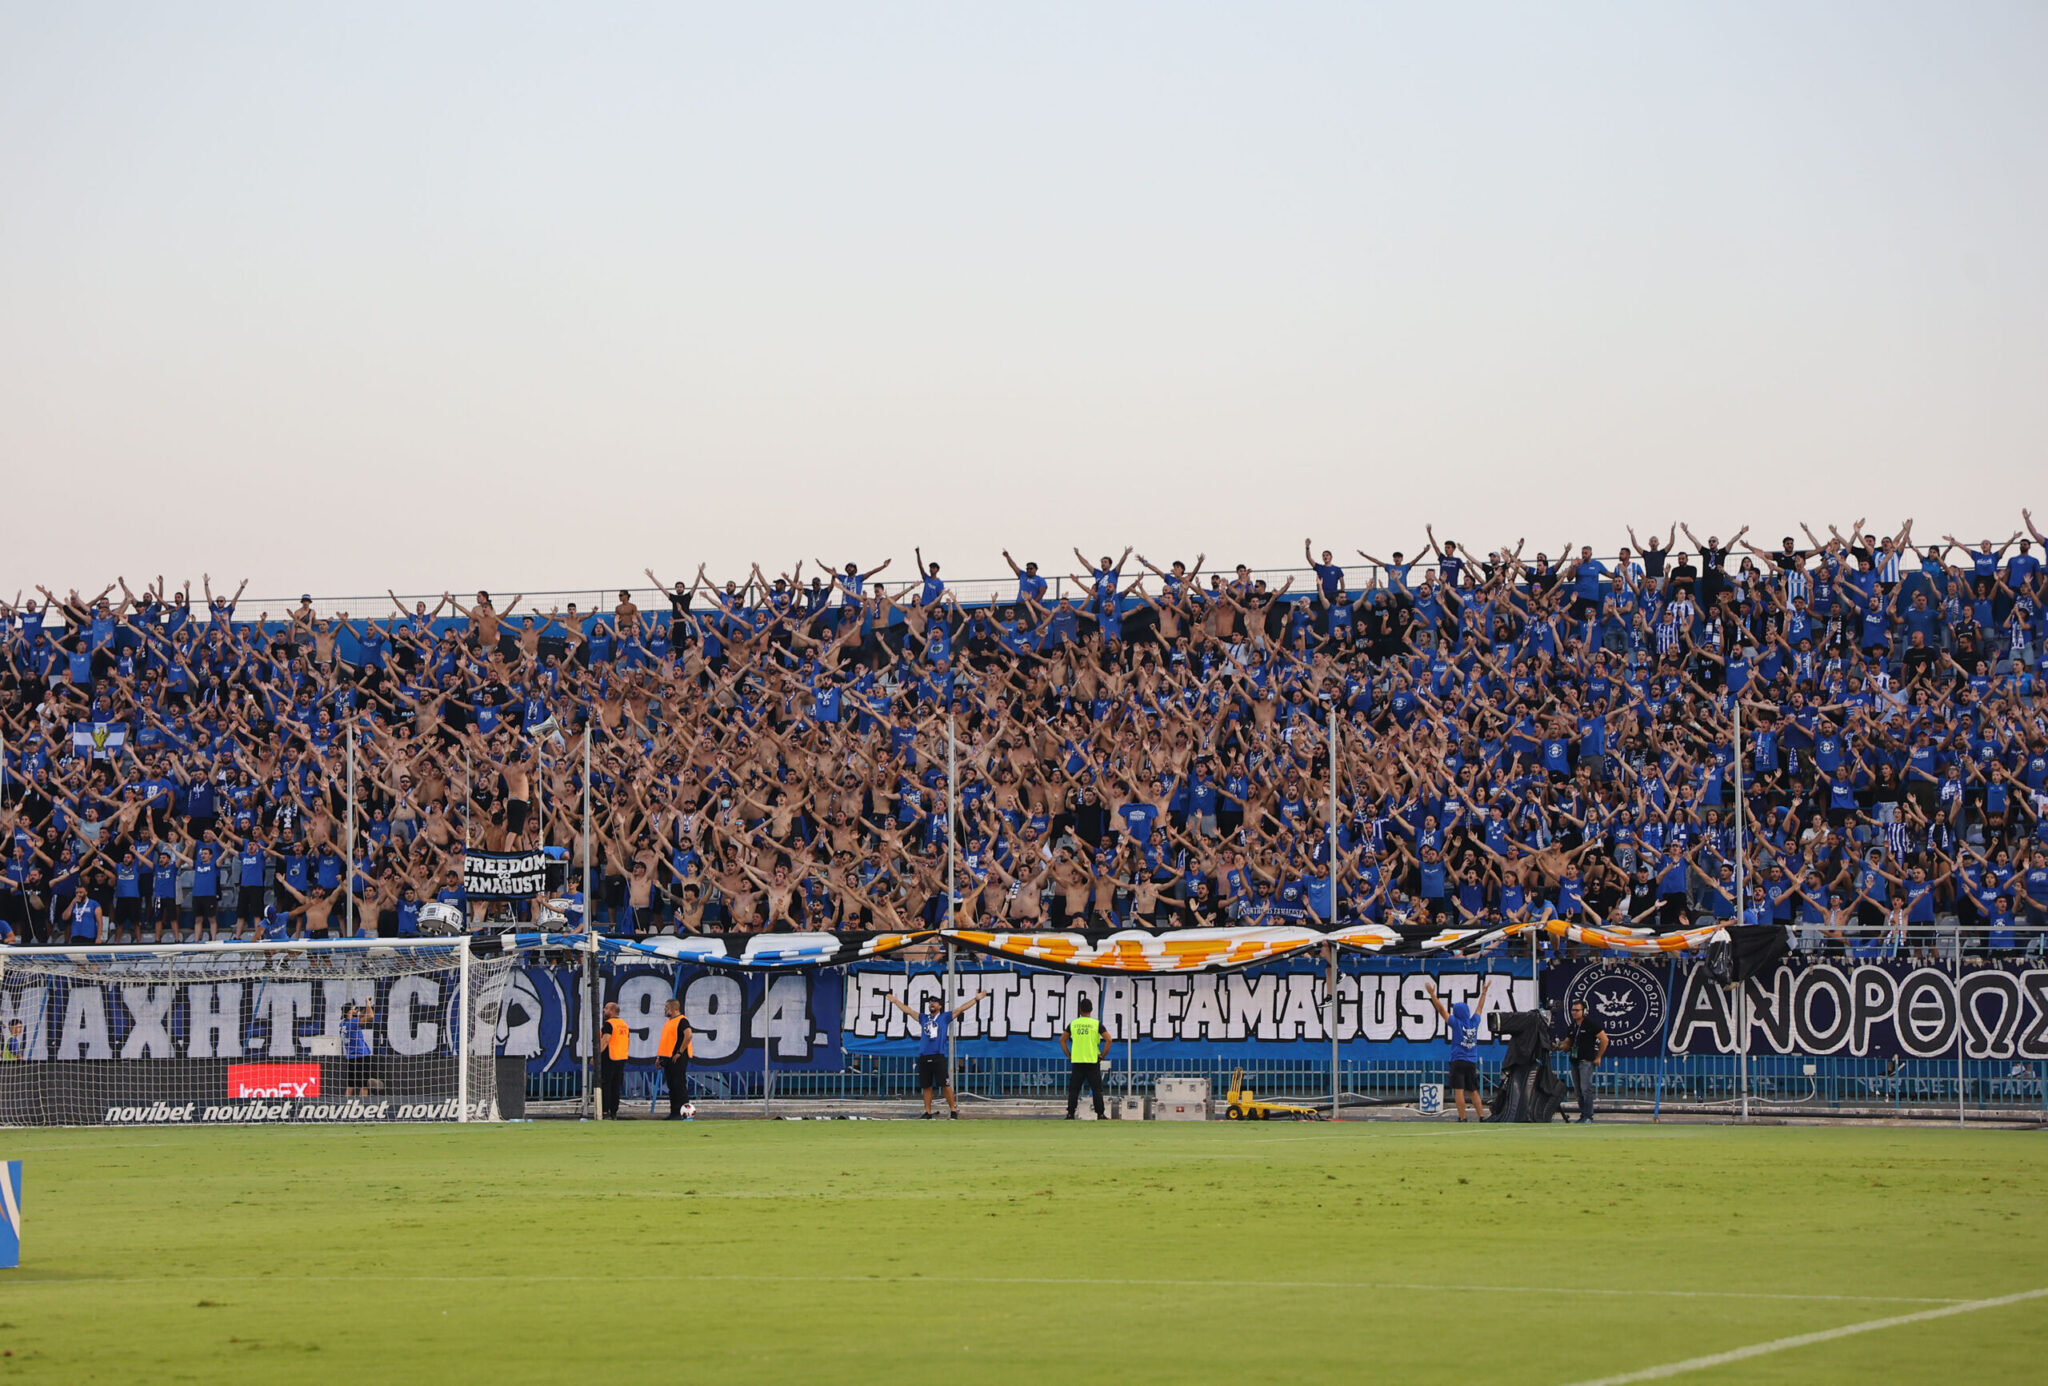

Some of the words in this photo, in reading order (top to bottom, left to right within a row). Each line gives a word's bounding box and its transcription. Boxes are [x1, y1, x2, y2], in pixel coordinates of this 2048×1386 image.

[464, 854, 546, 874] FREEDOM
[498, 870, 511, 879] to
[1603, 1020, 1630, 1029] 1911
[1610, 1029, 1647, 1047] ΧΩΣΤΟΥ
[105, 1101, 196, 1122] novibet
[202, 1100, 293, 1121] novibet
[299, 1099, 389, 1119] novibet
